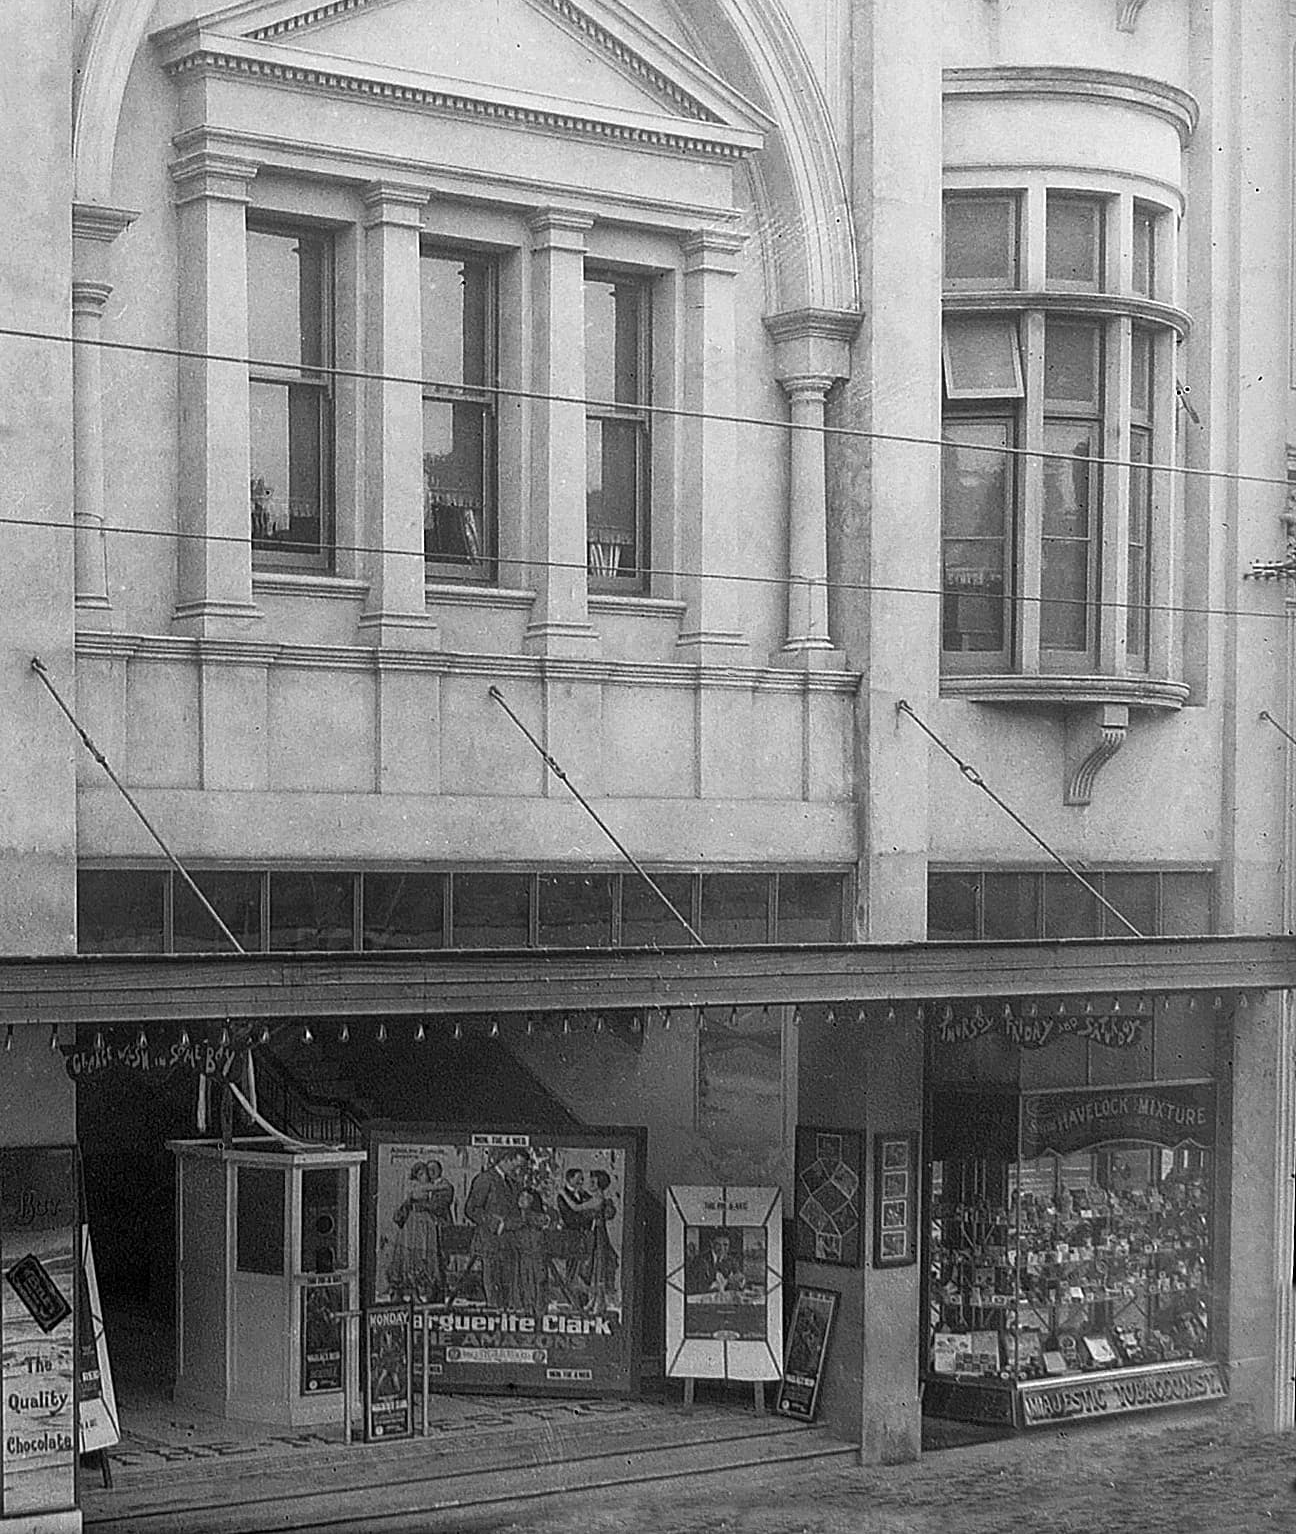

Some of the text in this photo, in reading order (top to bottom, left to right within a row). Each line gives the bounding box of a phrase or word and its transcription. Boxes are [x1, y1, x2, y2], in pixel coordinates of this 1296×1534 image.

[1006, 1017, 1054, 1045] FRIDAY
[1055, 1096, 1129, 1133] HAVELOCK
[1137, 1097, 1207, 1127] MIXTURE
[369, 1311, 409, 1327] MONDAY
[412, 1312, 614, 1335] arguerite Clark
[24, 1356, 52, 1374] The
[8, 1390, 68, 1417] Quality
[1025, 1386, 1107, 1417] MAJESTIC
[6, 1432, 72, 1455] Chocolate
